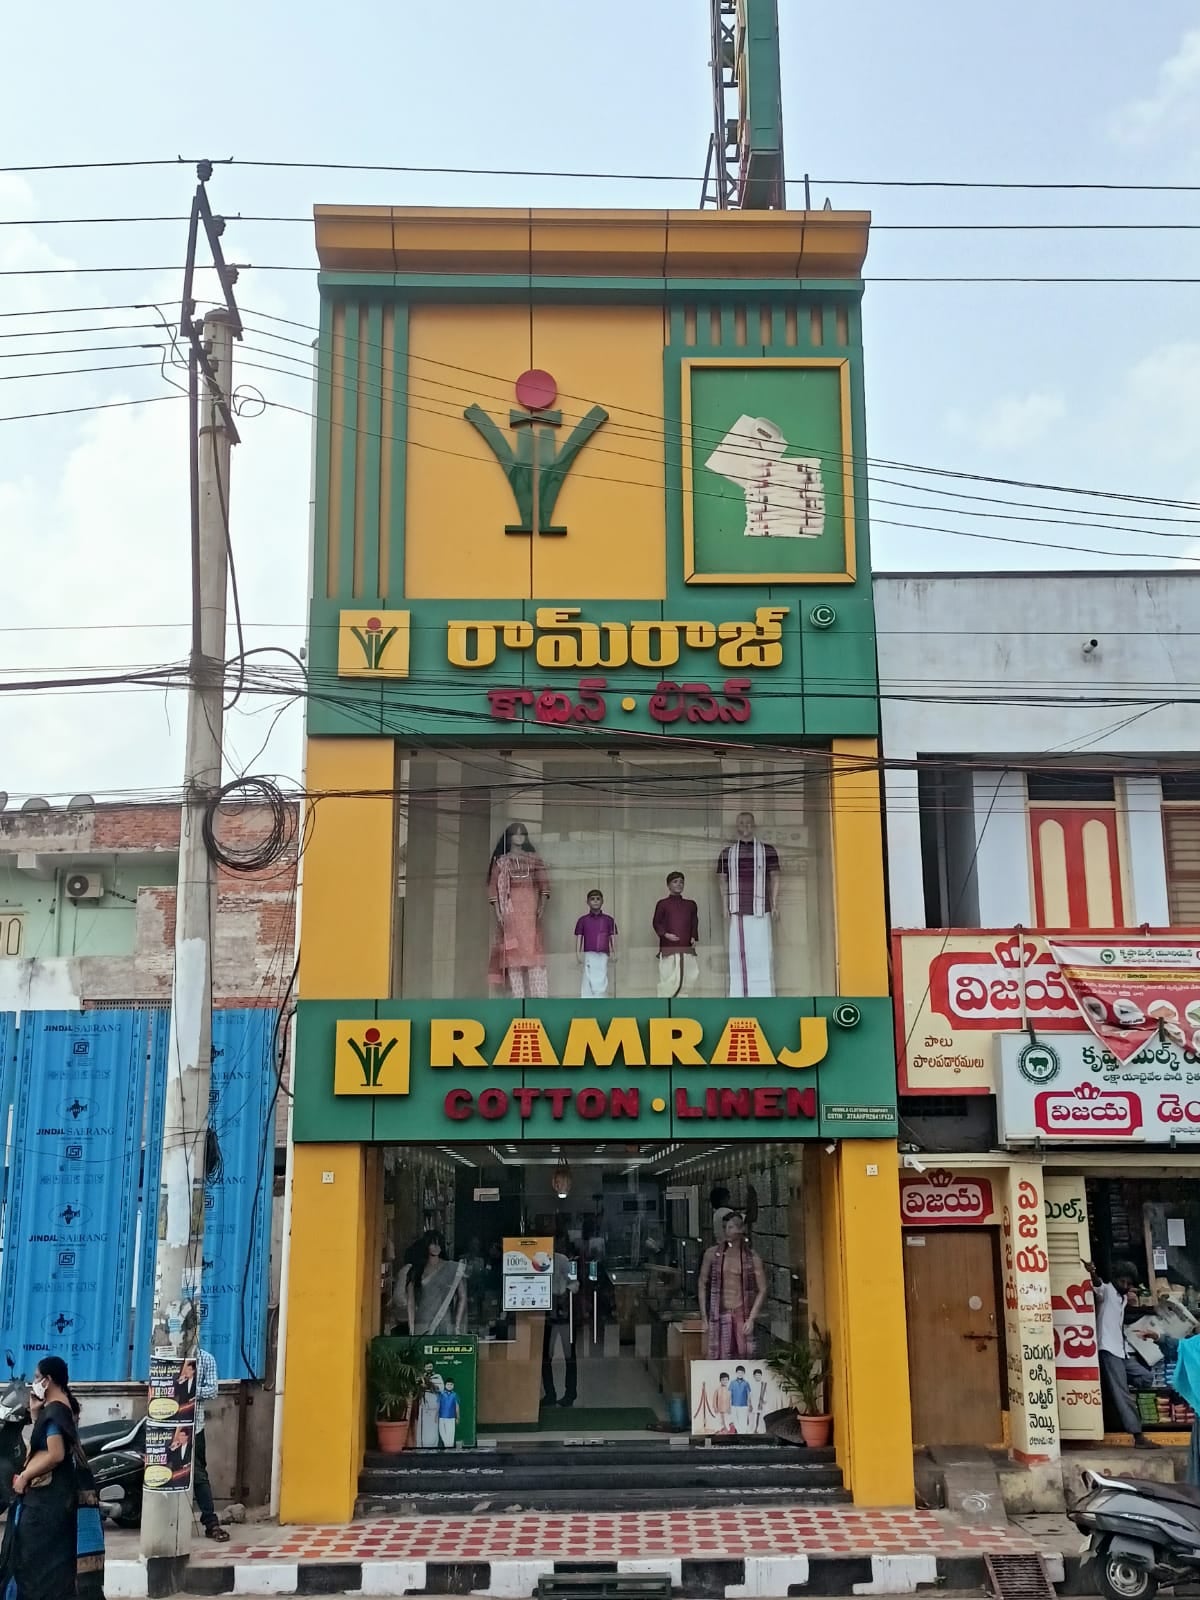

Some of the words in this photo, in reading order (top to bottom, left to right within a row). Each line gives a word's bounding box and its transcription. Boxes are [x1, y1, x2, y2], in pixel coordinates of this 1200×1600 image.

[430, 1017, 829, 1068] RAMRAJ
[924, 1035, 953, 1047] పాలు
[444, 1088, 640, 1120] COTTON
[677, 1088, 817, 1119] LINEN
[1051, 1103, 1127, 1121] విజయ
[906, 1188, 980, 1213] విజయ
